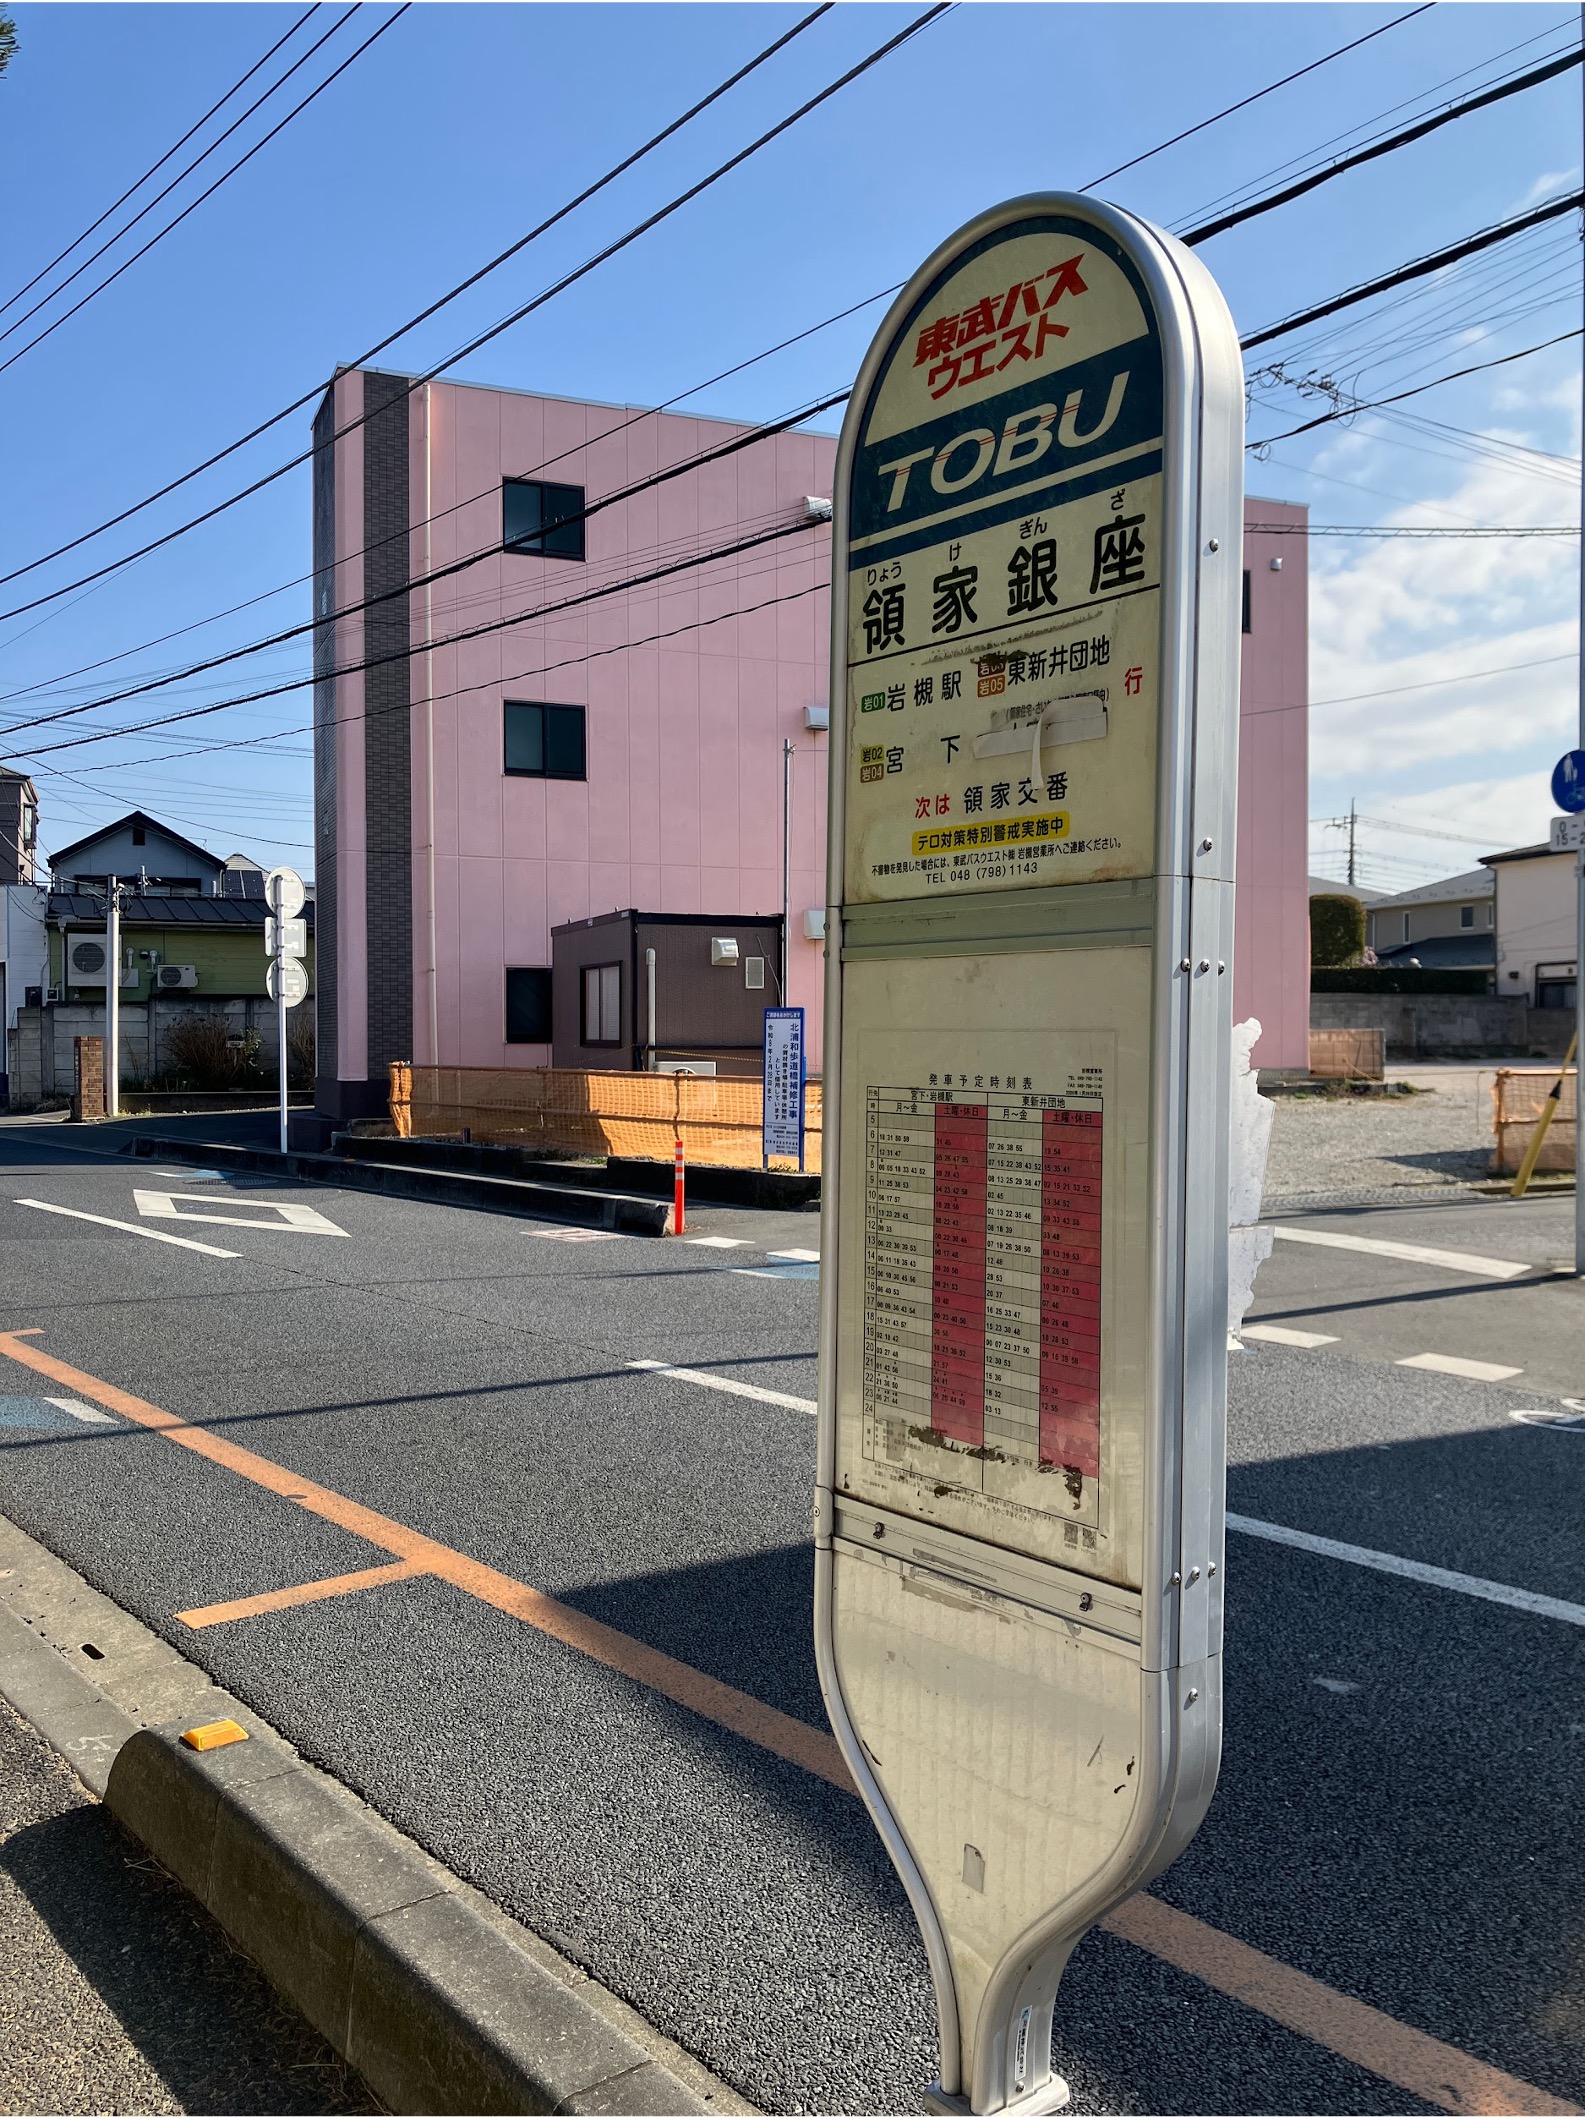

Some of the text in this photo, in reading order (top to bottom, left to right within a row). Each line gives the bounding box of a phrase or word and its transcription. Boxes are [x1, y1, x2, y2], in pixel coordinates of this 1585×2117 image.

[912, 252, 1089, 368] 東武バス
[927, 313, 1071, 401] ウエスト
[877, 370, 1131, 513] TOBU
[862, 513, 1146, 654] 領家銀座
[979, 634, 1110, 696] 岩05 東新井団地
[1124, 666, 1143, 696] 行
[862, 694, 885, 712] 岩01
[887, 670, 962, 713] 岩槻駅
[861, 746, 884, 763] 岩02
[861, 764, 883, 781] 岩04
[915, 771, 1069, 819] 次は 領家交番
[917, 816, 1064, 851] テロ対策特別警戒実施中
[926, 872, 946, 884] TEL
[950, 869, 970, 881] 048
[929, 1073, 1032, 1090] 発車予定時刻表
[1022, 1096, 1066, 1108] 東新井団地
